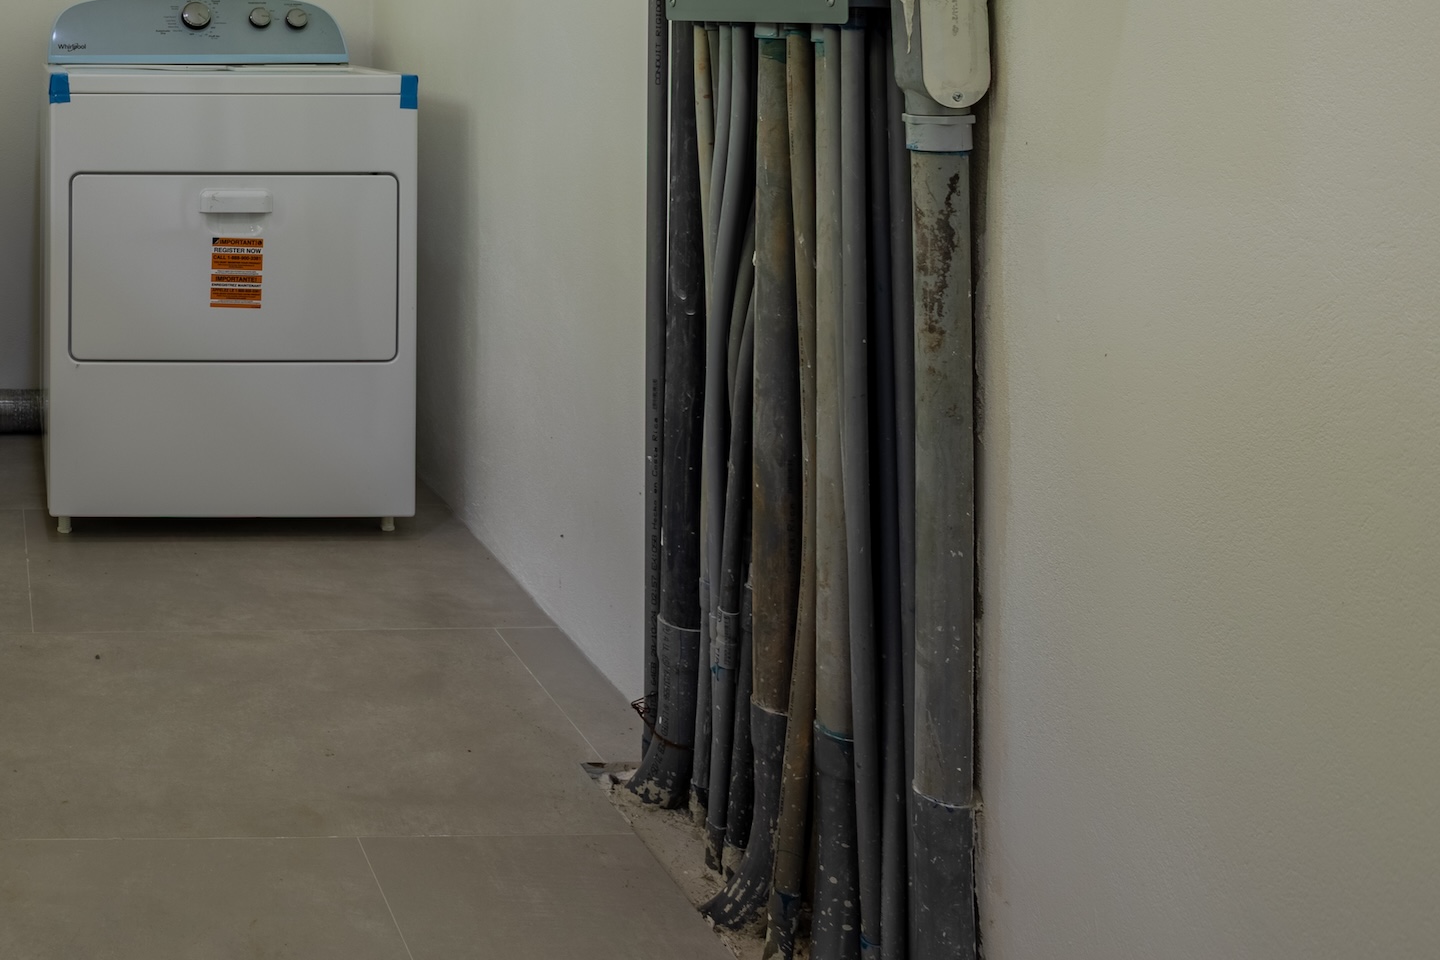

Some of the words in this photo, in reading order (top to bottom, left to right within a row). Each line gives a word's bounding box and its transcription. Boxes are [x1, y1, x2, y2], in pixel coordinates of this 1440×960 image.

[57, 43, 87, 52] Whirlpool
[651, 417, 659, 443] Rica
[651, 447, 659, 478] Costa
[653, 482, 659, 495] en
[651, 499, 659, 531] Hecho
[650, 574, 658, 606] 02:57
[660, 710, 670, 737] LISTED
